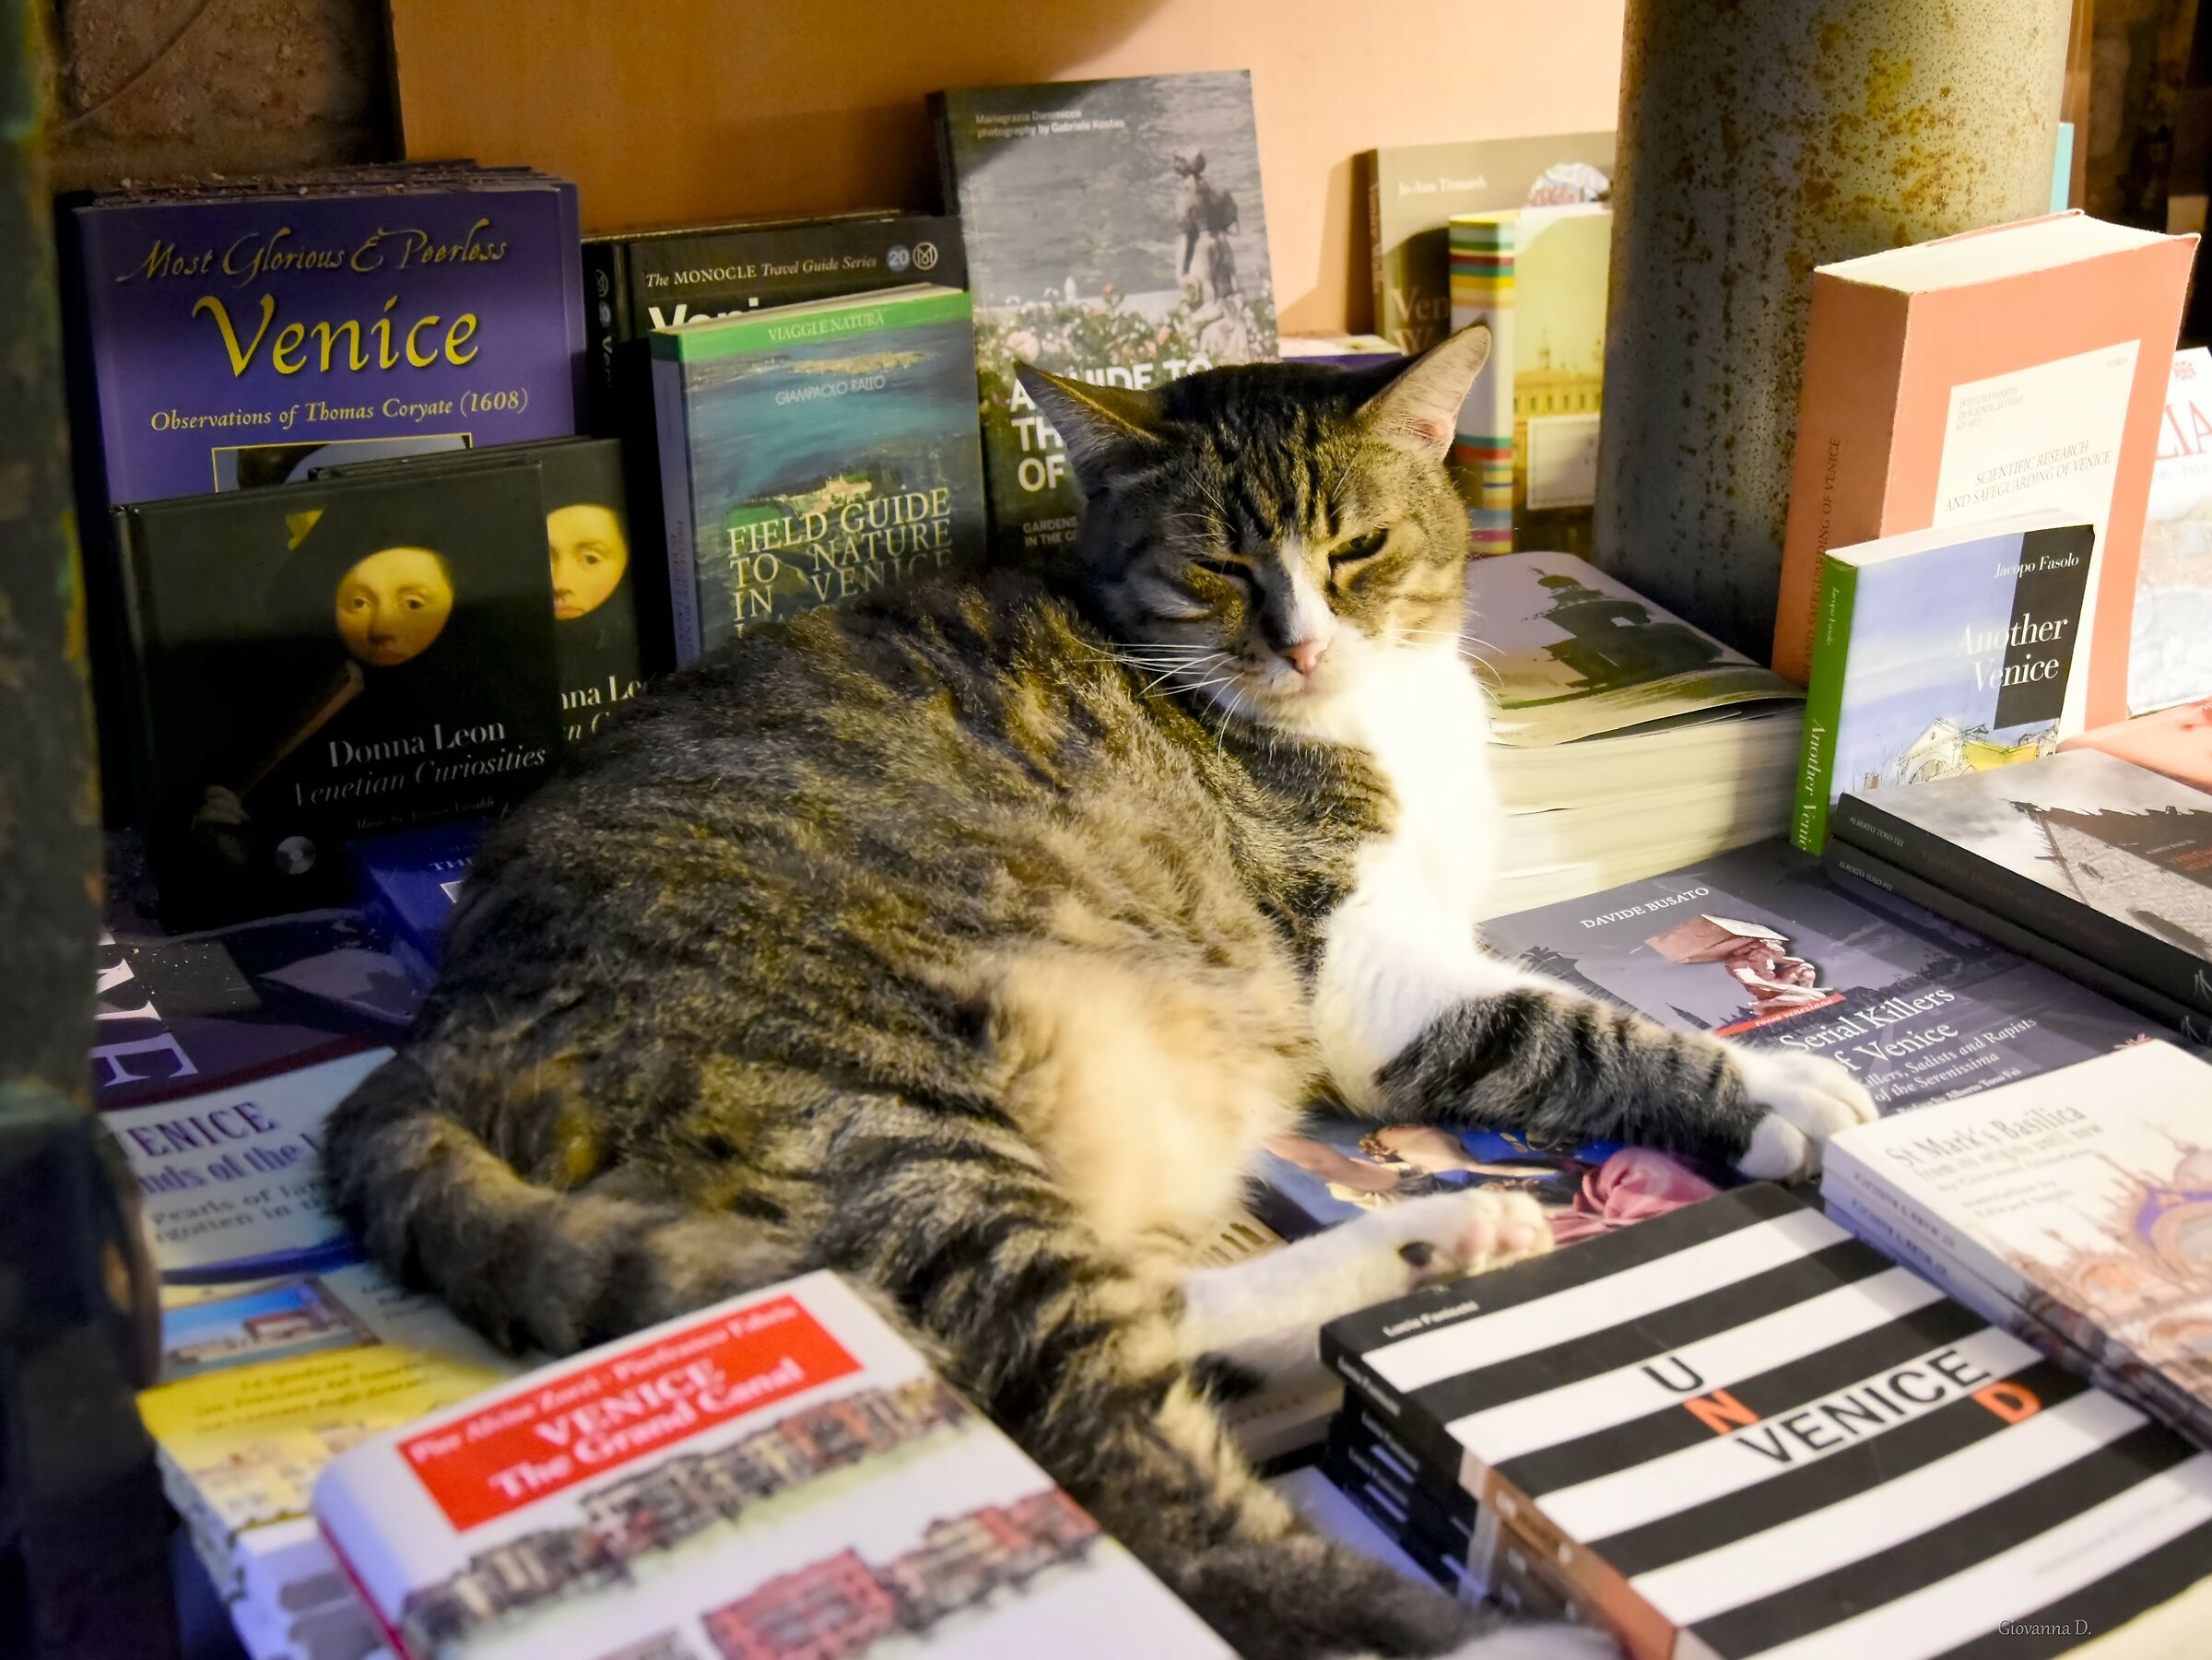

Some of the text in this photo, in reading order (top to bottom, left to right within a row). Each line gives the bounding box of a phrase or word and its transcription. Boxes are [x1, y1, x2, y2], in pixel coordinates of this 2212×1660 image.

[1038, 124, 1050, 135] by
[1051, 120, 1091, 134] Gabriele
[117, 240, 213, 283] Most
[222, 227, 345, 288] Glorious
[379, 218, 508, 269] Peerless
[646, 254, 877, 288] The MONOCLE Travel Guide Series
[888, 249, 910, 267] 20
[830, 309, 885, 332] NATURA
[1392, 288, 1450, 323] Ven
[192, 295, 479, 379] Venice
[151, 386, 528, 433] Observations of Thomas Coryate (1608)
[775, 374, 886, 406] GIAMPAOLO RALLO
[1011, 415, 1064, 452] TH
[1018, 454, 1066, 492] OF
[1825, 437, 1841, 490] VENICE
[1945, 450, 2112, 513] AND SAFEGUARDING OF VENICE
[1975, 440, 2089, 487] SCIENTIFIC RESEARCH
[726, 487, 951, 559] FIELD GUIDE
[1822, 495, 1834, 515] OF
[729, 518, 953, 589] TO NATURE
[1024, 536, 1038, 547] IN
[1039, 532, 1063, 546] THE
[733, 549, 953, 622] IN VENICE
[1994, 552, 2079, 580] Jacopo Fasolo
[1955, 612, 2068, 661] Another
[609, 675, 641, 701] Le
[1972, 653, 2060, 692] Venice
[327, 722, 507, 769] Donna Leon
[1806, 718, 1827, 797] Another
[295, 744, 547, 808] Venetian Curiosities
[1801, 802, 1818, 852] Venic
[1850, 817, 1877, 834] ALBERTO
[1838, 861, 1865, 878] ALBERTO
[1581, 887, 1710, 929] DAVIDE BUSATO
[1779, 985, 1956, 1053] Serial Killers
[1834, 1021, 1960, 1073] f Venice
[1858, 1017, 2038, 1089] illers, Sadists and Rapists
[1874, 1052, 2000, 1102] of the Serenissima
[126, 1101, 277, 1158] ENICE
[1886, 1104, 2087, 1168] St Mark's Basilica
[138, 1166, 207, 1194] nds
[243, 1145, 299, 1172] the
[1641, 1356, 1705, 1393] U
[534, 1358, 726, 1446] VENICE
[1683, 1388, 1761, 1435] N
[1735, 1348, 1993, 1464] VENICE
[1971, 1381, 2042, 1426] D
[488, 1356, 806, 1501] The Grand Canal
